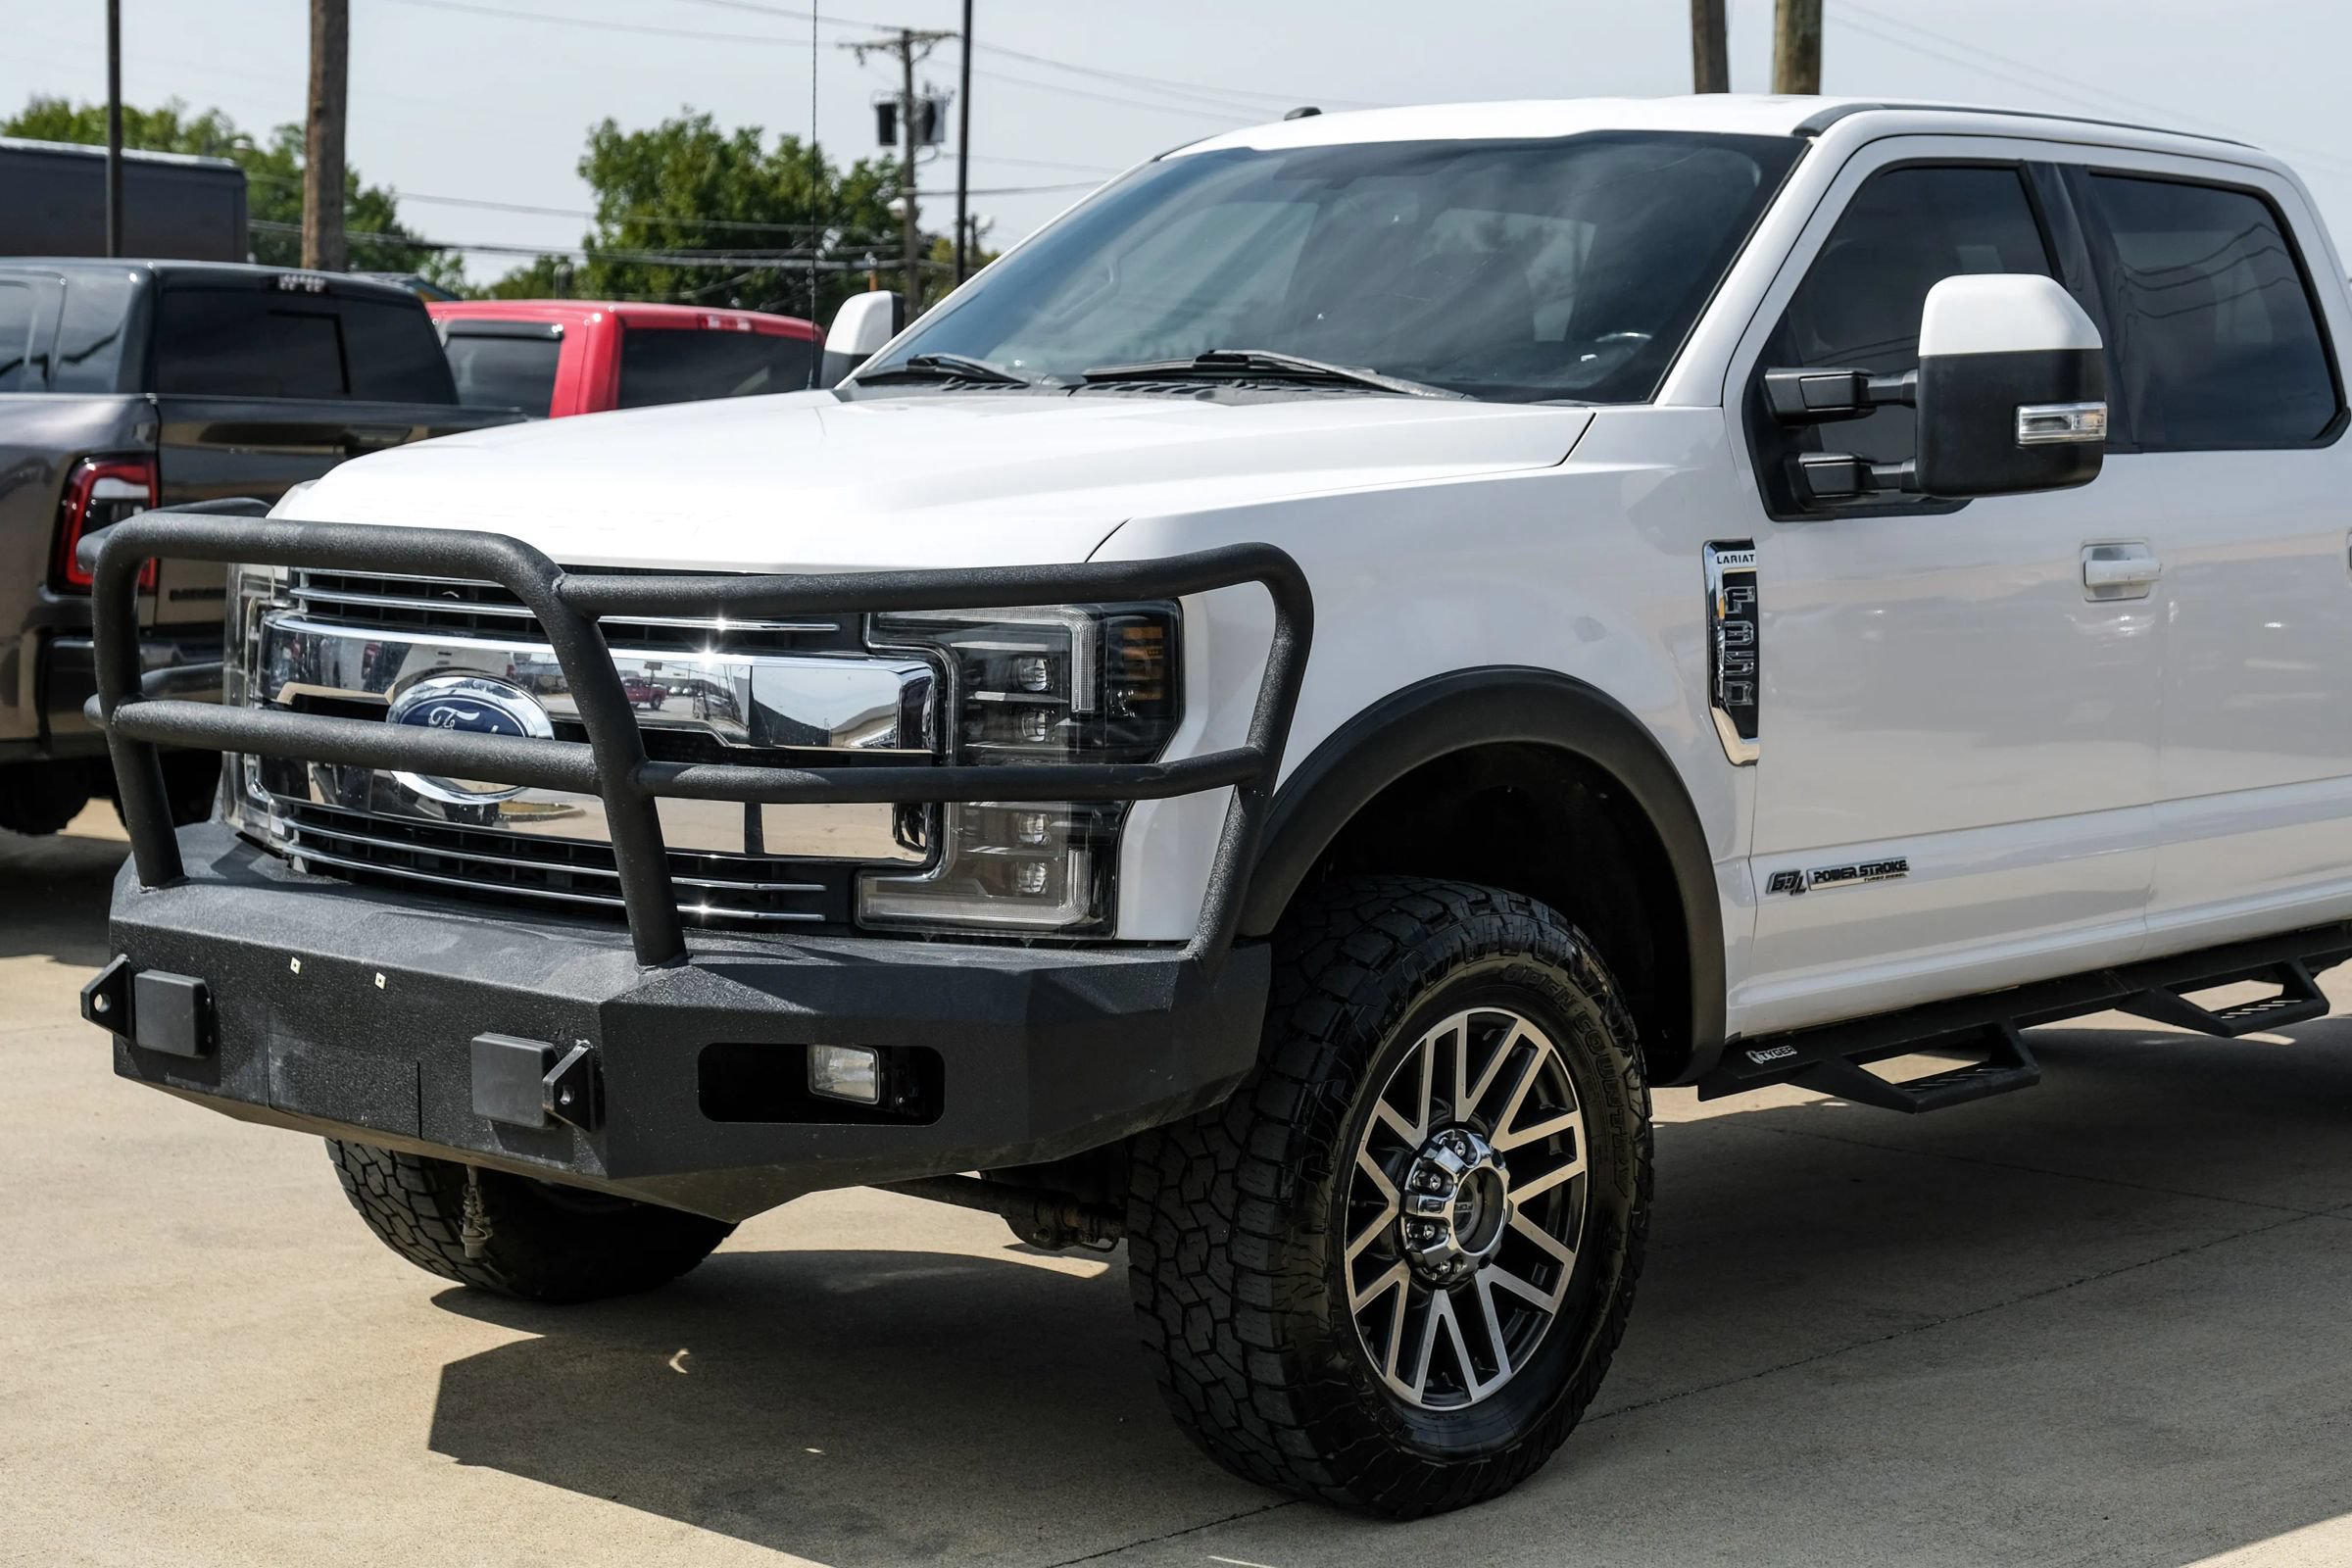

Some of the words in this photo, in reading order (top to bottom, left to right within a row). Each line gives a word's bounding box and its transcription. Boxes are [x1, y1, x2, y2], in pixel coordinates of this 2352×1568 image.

[1716, 554, 1755, 564] LARIAT
[1813, 866, 1857, 883] POWER
[1859, 859, 1907, 877] STROKE
[1503, 964, 1576, 1013] OPEN
[1574, 1011, 1631, 1198] COUNTRY
